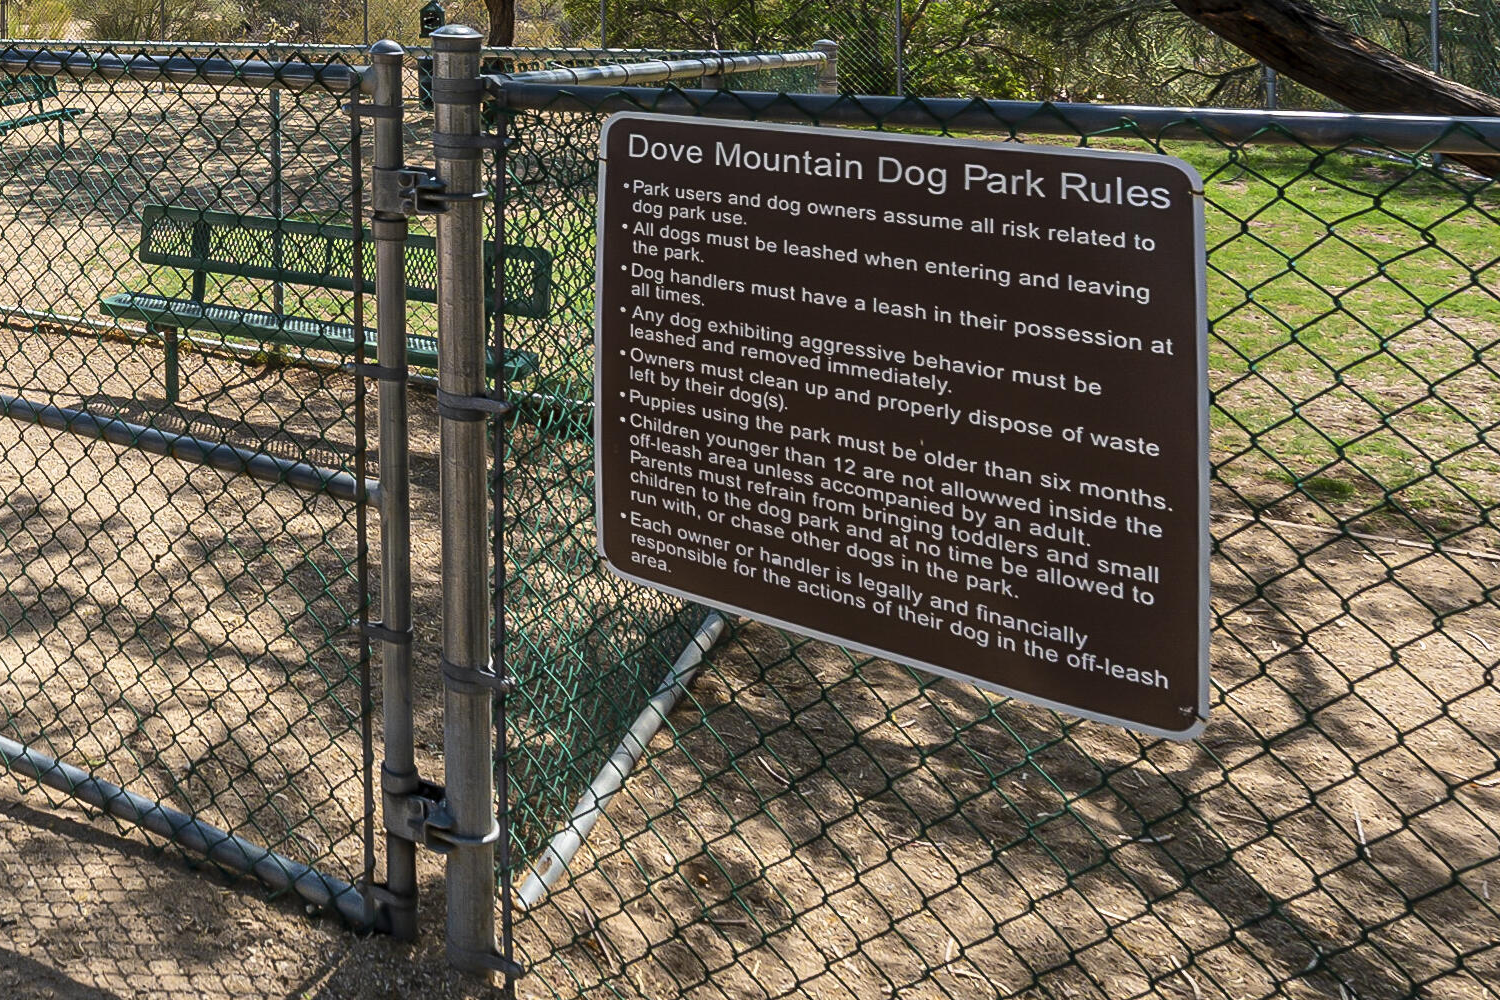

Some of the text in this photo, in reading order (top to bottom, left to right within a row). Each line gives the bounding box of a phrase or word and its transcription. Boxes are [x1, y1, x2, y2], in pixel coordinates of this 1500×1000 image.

[629, 133, 1171, 210] Dove Mountain Dog Park Rules
[632, 199, 747, 225] dog park use.
[633, 179, 1156, 252] Park users and dog owners assume all risk related to
[631, 282, 705, 307] all times.
[632, 239, 705, 263] the park.
[632, 221, 1150, 305] All dogs must be leashed when entering and leaving
[631, 262, 1174, 356] Dog handlers must have a leash in their possession at
[631, 305, 1102, 396] Any dog exhibiting aggressive behavior must be
[629, 365, 788, 413] left by their dog(s).
[630, 323, 952, 396] leashed and removed immediately.
[630, 347, 1160, 457] Owners must clean up and properly dispose of waste
[629, 388, 1173, 512] Puppies using the park must be older than six months.
[629, 412, 1163, 539] Children younger than 12 are not allowwed inside the
[629, 432, 1091, 547] off-leash area unless accompanied by an adult.
[630, 449, 1159, 584] Parents must refrain from bringing toddlers and small
[630, 470, 1155, 606] children to the dog park and at no time be allowed to
[630, 490, 1019, 599] run with, or chase other dogs in the park.
[631, 551, 672, 574] area.
[630, 510, 1088, 651] Each owner or handler is legally and financially
[631, 533, 1169, 690] responsible for the actions of their dog in the off-leash
